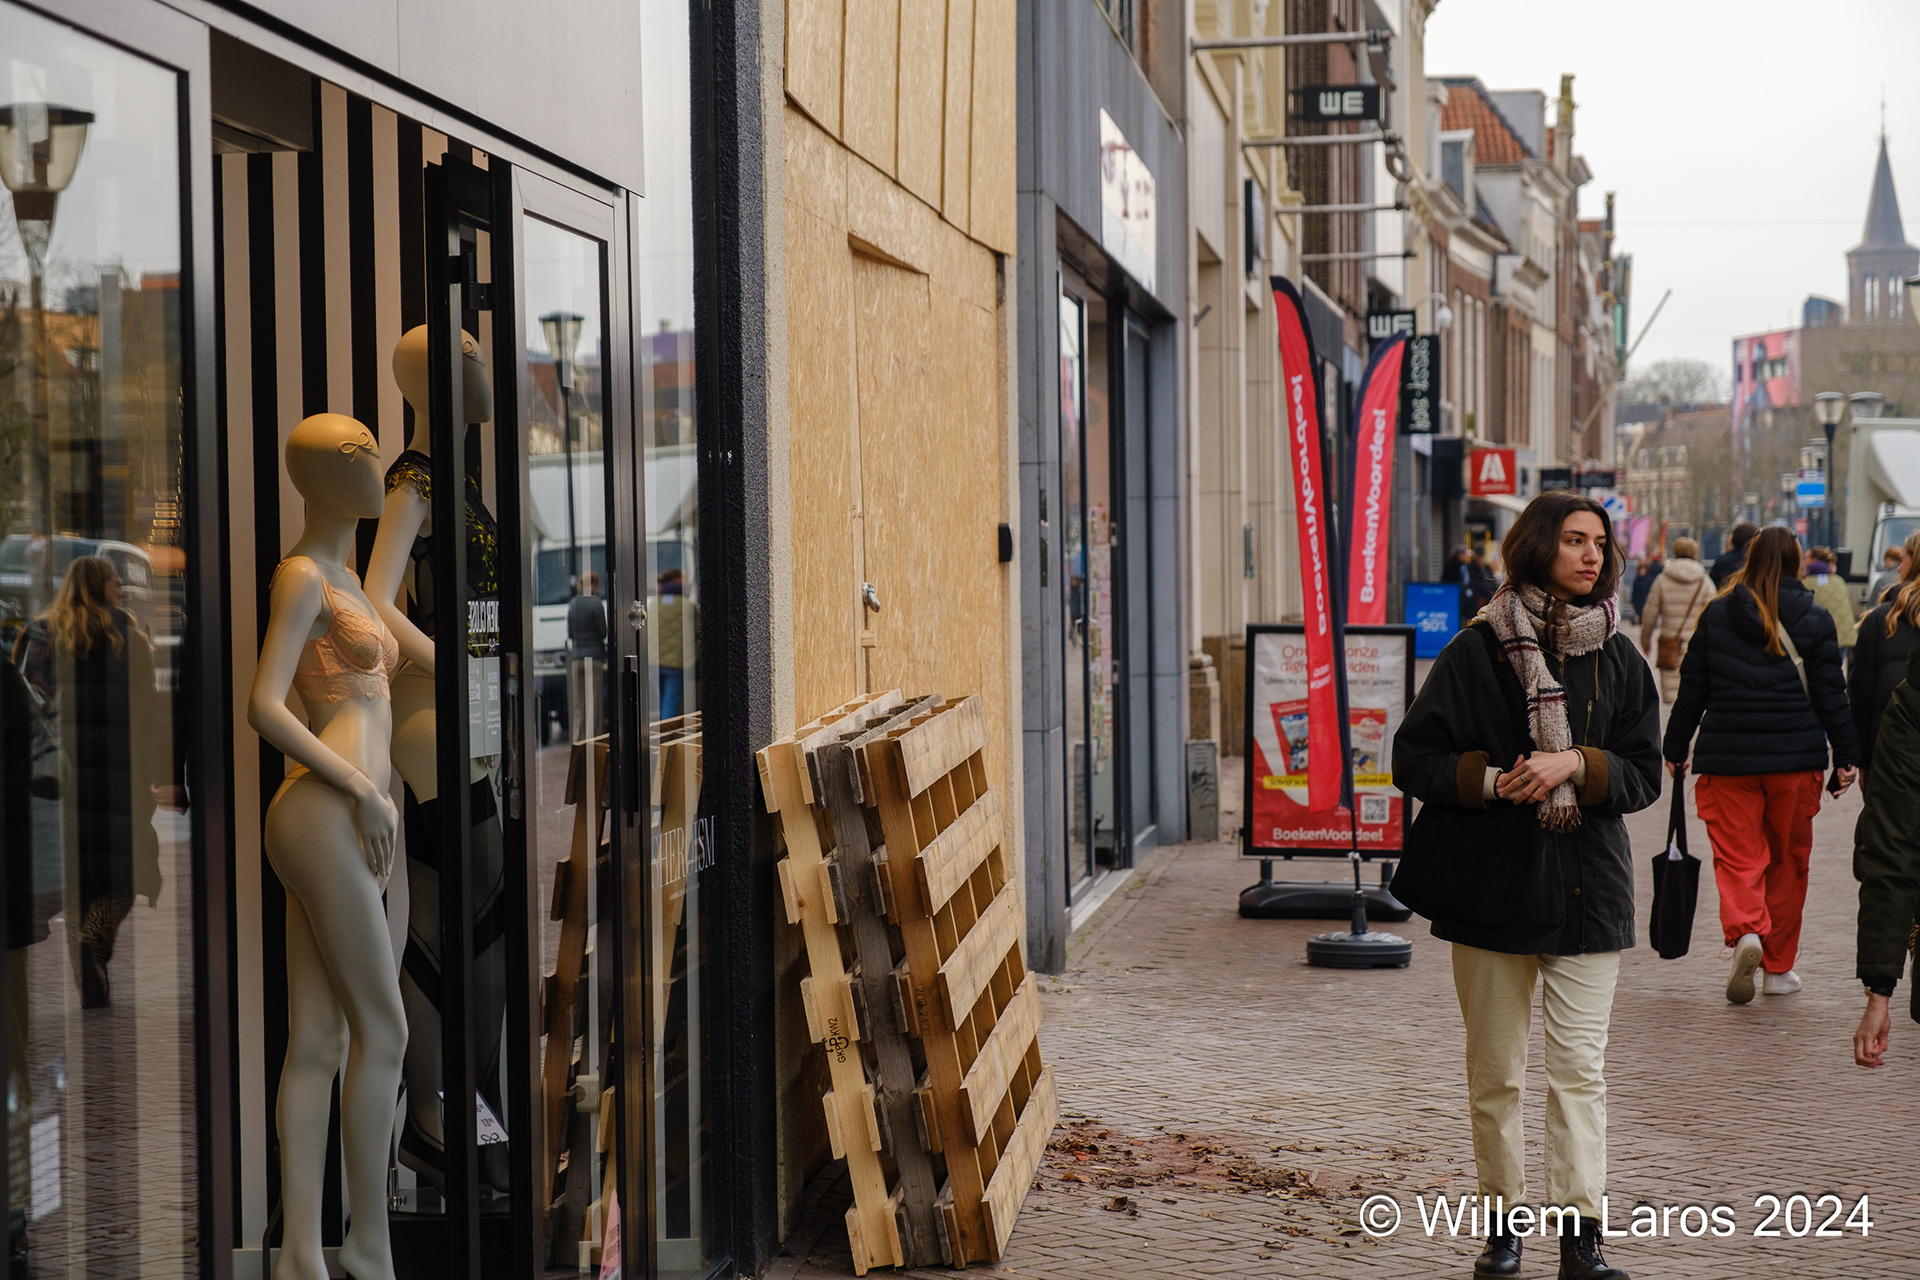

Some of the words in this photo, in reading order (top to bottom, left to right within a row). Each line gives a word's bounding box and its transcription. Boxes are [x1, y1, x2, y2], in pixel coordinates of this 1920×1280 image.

[1319, 91, 1364, 115] WE
[1369, 314, 1414, 338] WE
[1360, 408, 1386, 603] BoekenVoordeel
[1273, 827, 1384, 842] BoekenVoordeel
